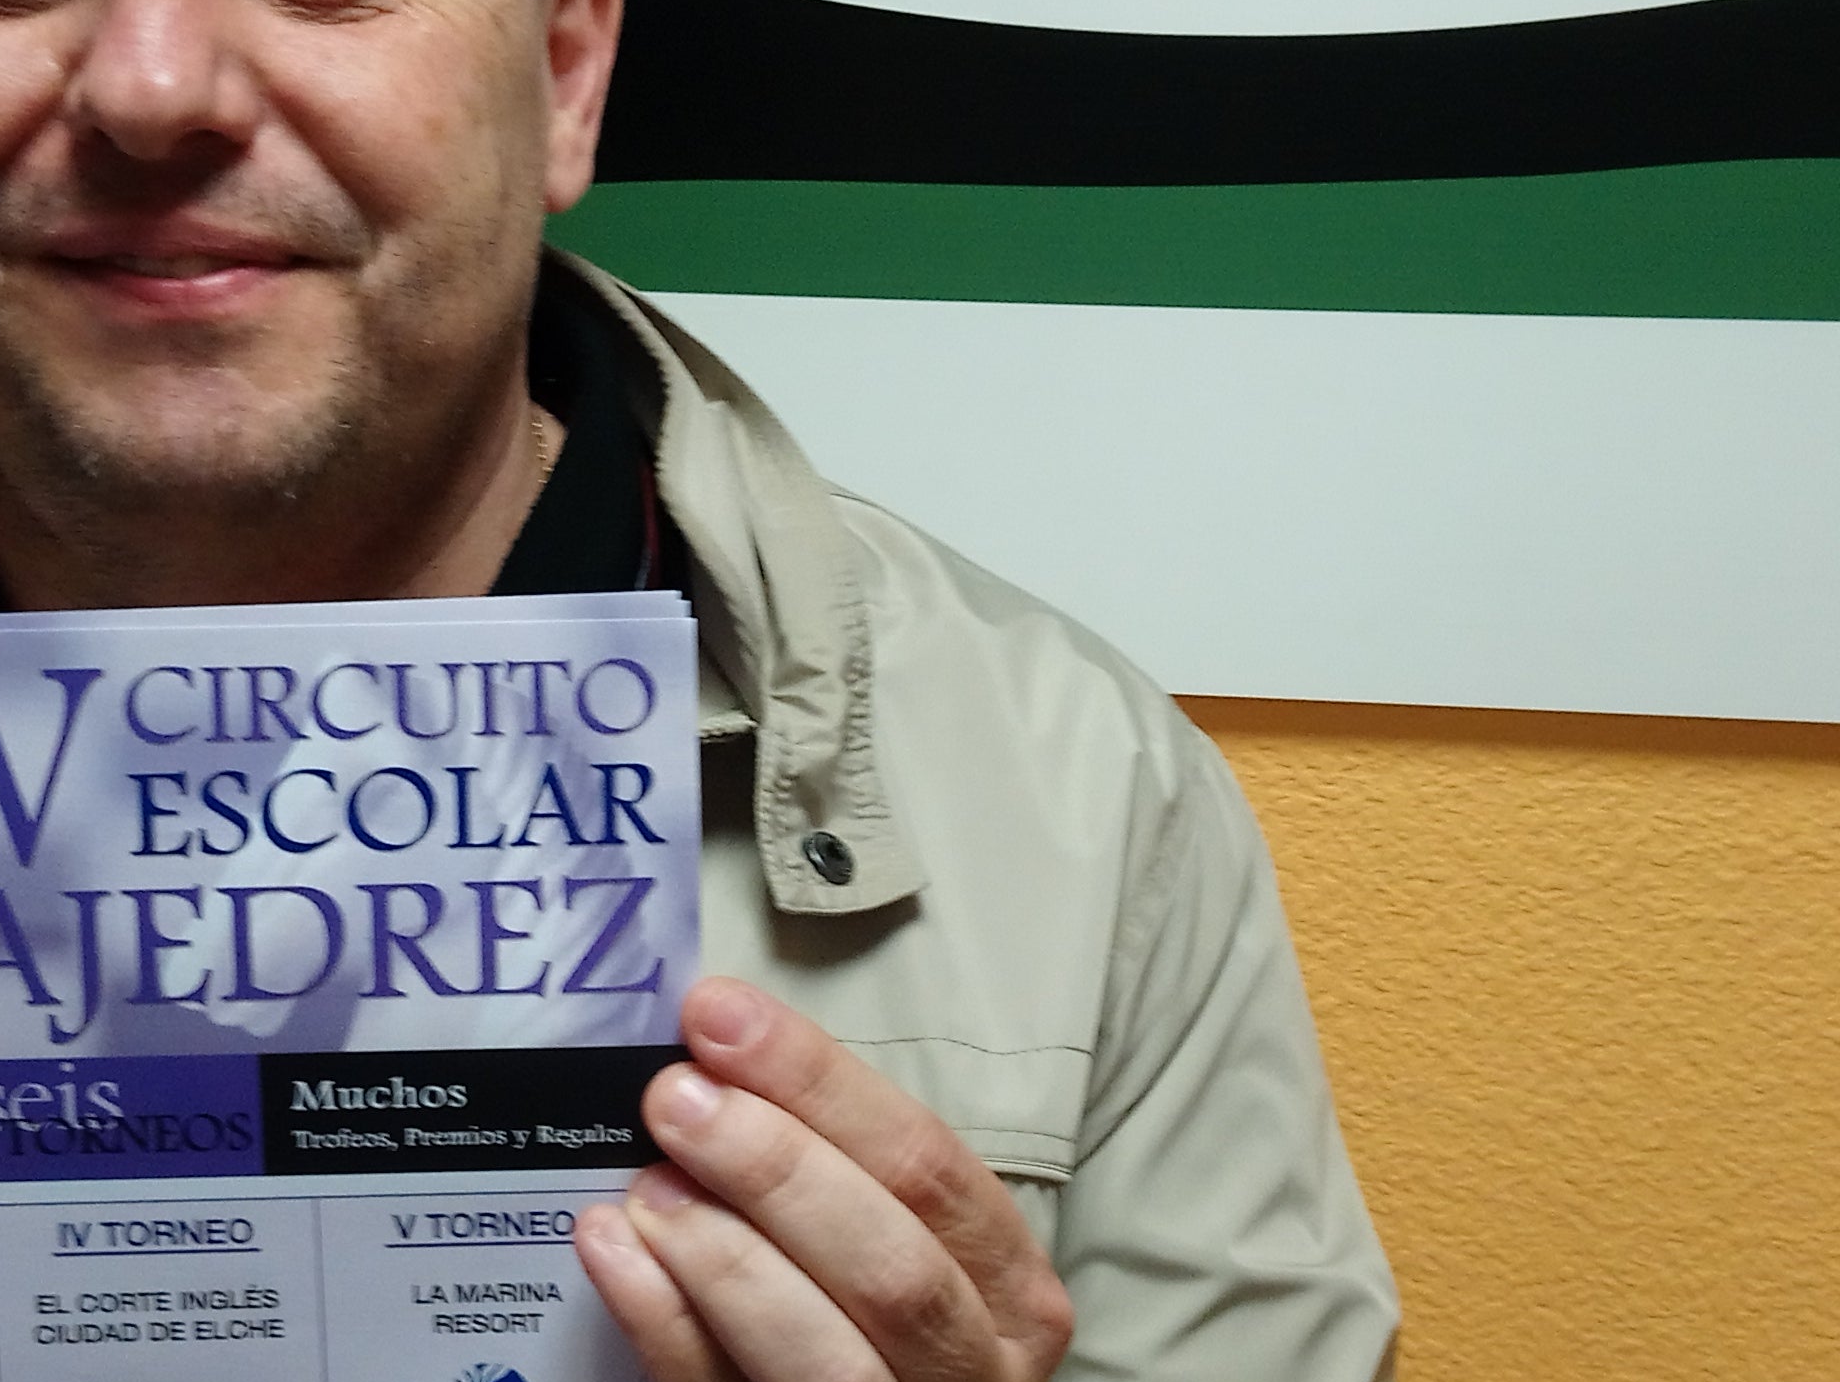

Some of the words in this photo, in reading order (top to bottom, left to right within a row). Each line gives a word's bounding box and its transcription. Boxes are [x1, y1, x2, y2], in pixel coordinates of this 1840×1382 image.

[125, 657, 658, 746] CIRCUITO
[126, 762, 667, 859] ESCOLAR
[289, 1074, 467, 1113] Muchos
[6, 1111, 254, 1158] TORNEOS
[291, 1124, 398, 1152] Trofeos,
[402, 1121, 505, 1149] Premios
[510, 1126, 530, 1149] y
[535, 1121, 633, 1148] Regalos
[58, 1222, 91, 1248] IV
[100, 1220, 254, 1247] TORNEO
[393, 1214, 416, 1239] V
[428, 1211, 576, 1237] TORNEO
[37, 1294, 69, 1314] EL
[81, 1291, 172, 1313] CORTE
[181, 1287, 279, 1312] INGLÉS
[412, 1285, 448, 1305] LA
[457, 1282, 563, 1304] MARINA
[34, 1323, 142, 1345] CIUDAD
[151, 1323, 185, 1343] DE
[194, 1321, 286, 1341] ELCHE
[434, 1314, 543, 1335] RESORT
